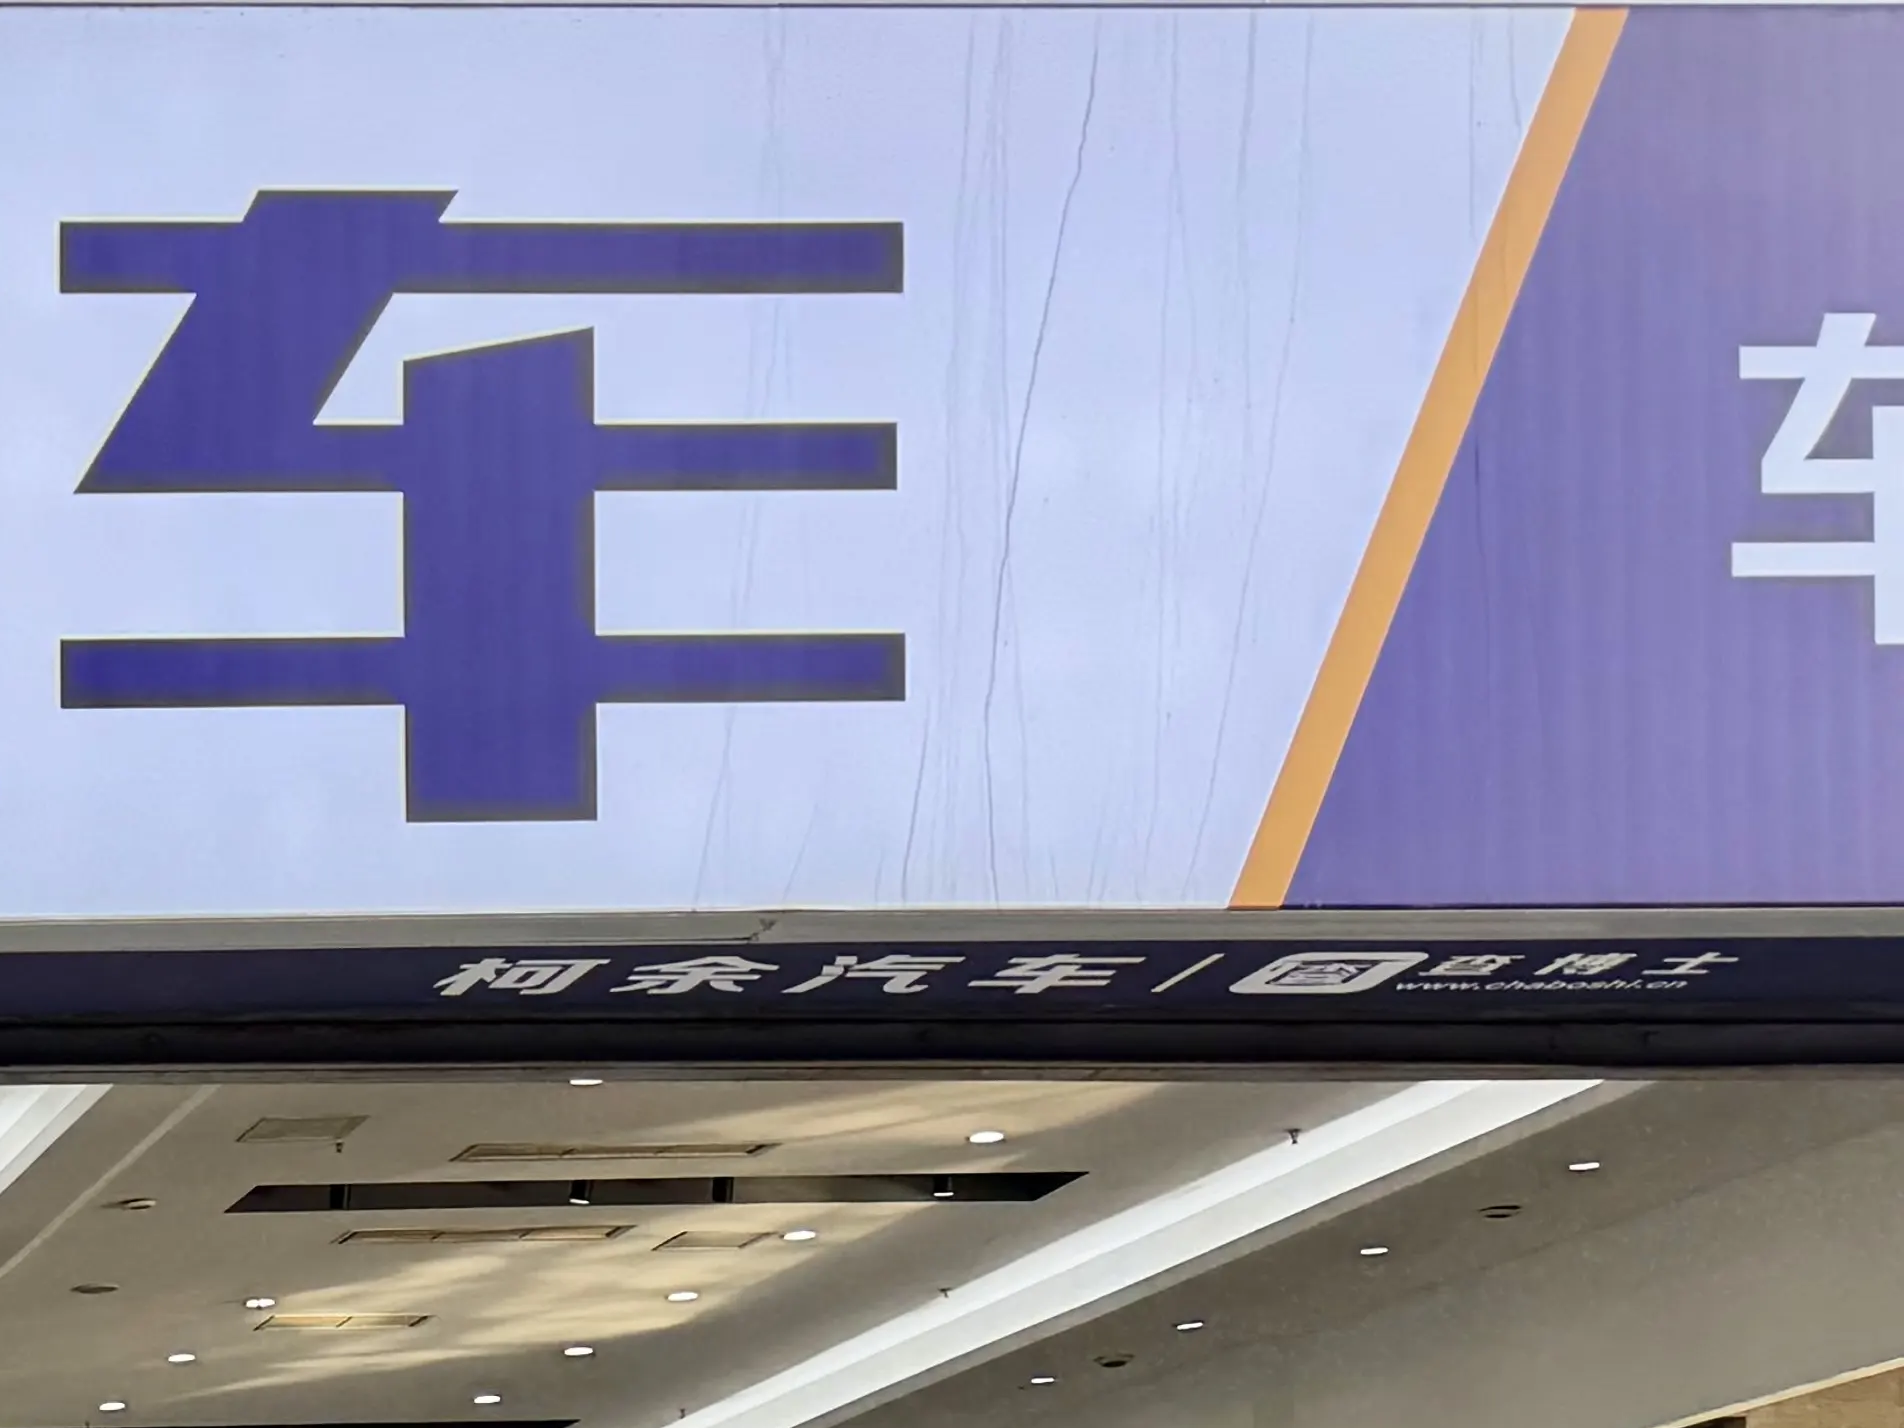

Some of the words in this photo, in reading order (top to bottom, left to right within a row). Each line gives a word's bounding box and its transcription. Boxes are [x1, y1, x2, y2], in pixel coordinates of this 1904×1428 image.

[433, 953, 1146, 995] 柯余汽车
[1419, 951, 1739, 977] 查博士
